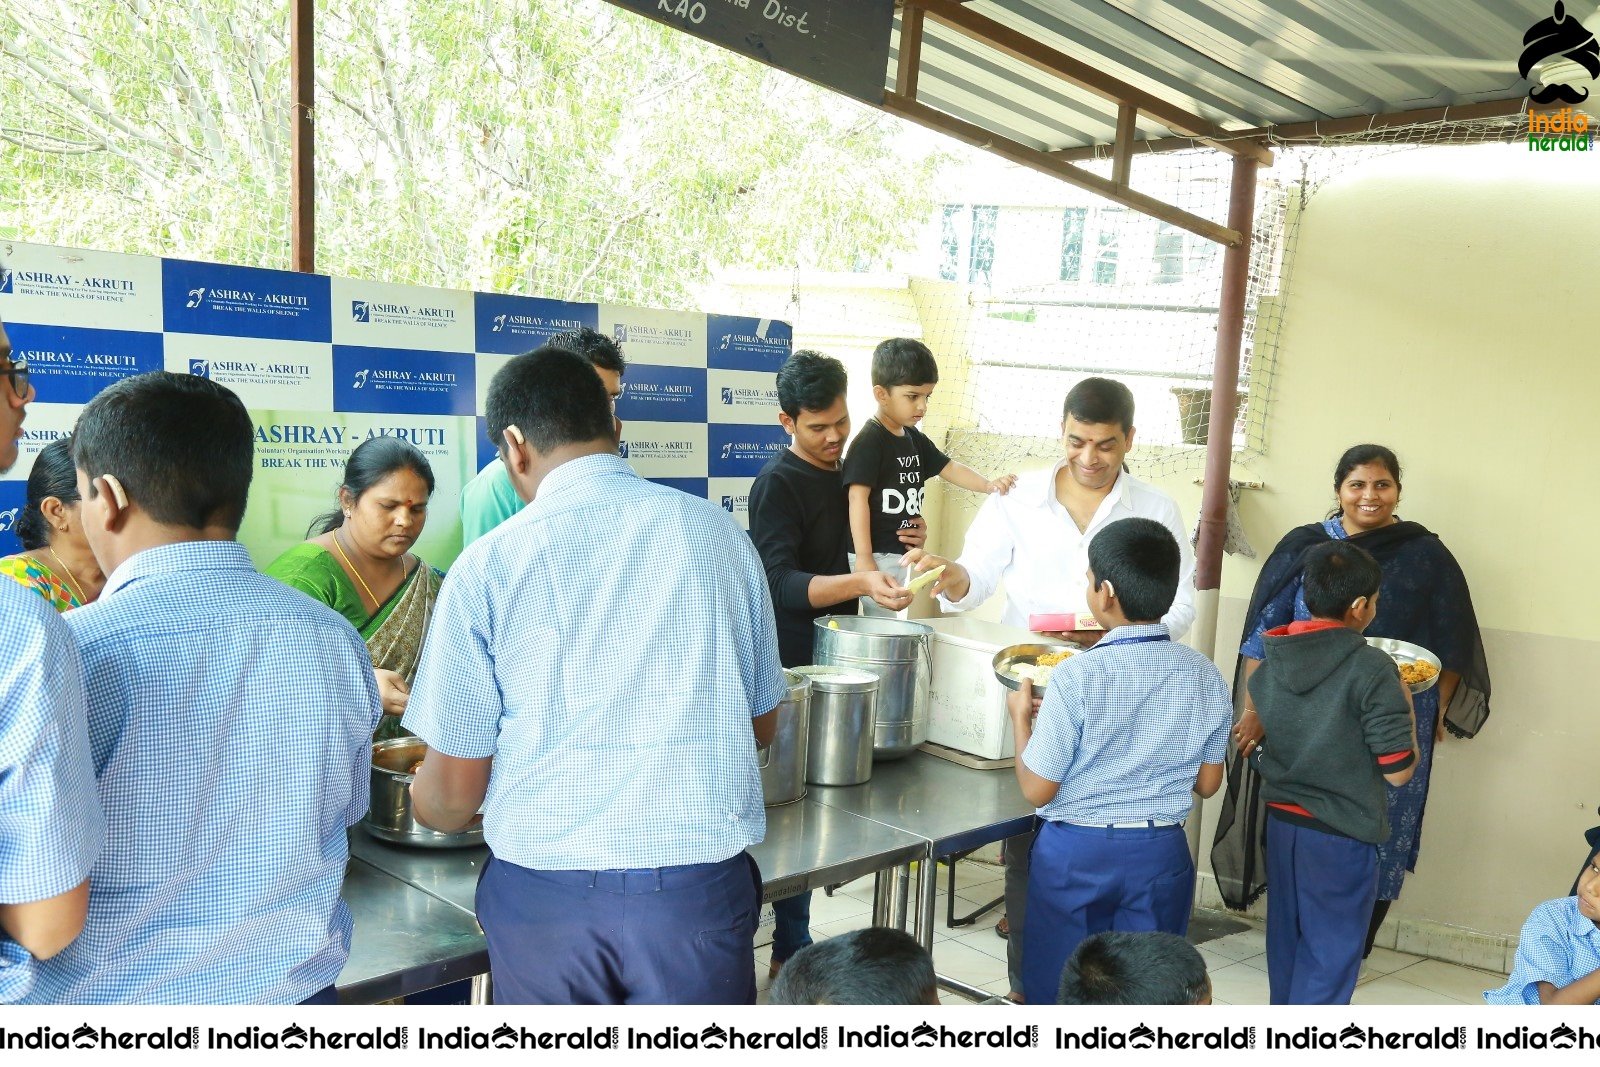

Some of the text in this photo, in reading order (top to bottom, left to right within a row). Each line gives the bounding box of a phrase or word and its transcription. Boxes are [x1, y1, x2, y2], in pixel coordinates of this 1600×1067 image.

[15, 271, 72, 285] ASHRAY
[82, 277, 133, 291] AKRUTI
[208, 288, 256, 301] ASHRAY
[264, 294, 307, 306] AKRUTI
[371, 304, 410, 315] ASHRAY
[417, 308, 455, 318] AKRUTI
[508, 315, 543, 325] ASHRAY
[549, 319, 581, 328] AKRUTI
[18, 350, 74, 363] ASHRAY
[84, 354, 136, 366] AKRUTI
[211, 361, 257, 372] ASHRAY
[266, 364, 309, 375] AKRUTI
[371, 370, 412, 380] ASHRAY
[418, 372, 455, 382] AKRUTI
[629, 383, 659, 392] ASHRAY
[664, 385, 692, 394] AKRUTI
[253, 425, 346, 444] ASHRAY
[630, 441, 659, 449] ASHRAY
[665, 441, 692, 450] AKRUTI
[262, 458, 302, 468] BREAK
[304, 459, 327, 468] THE
